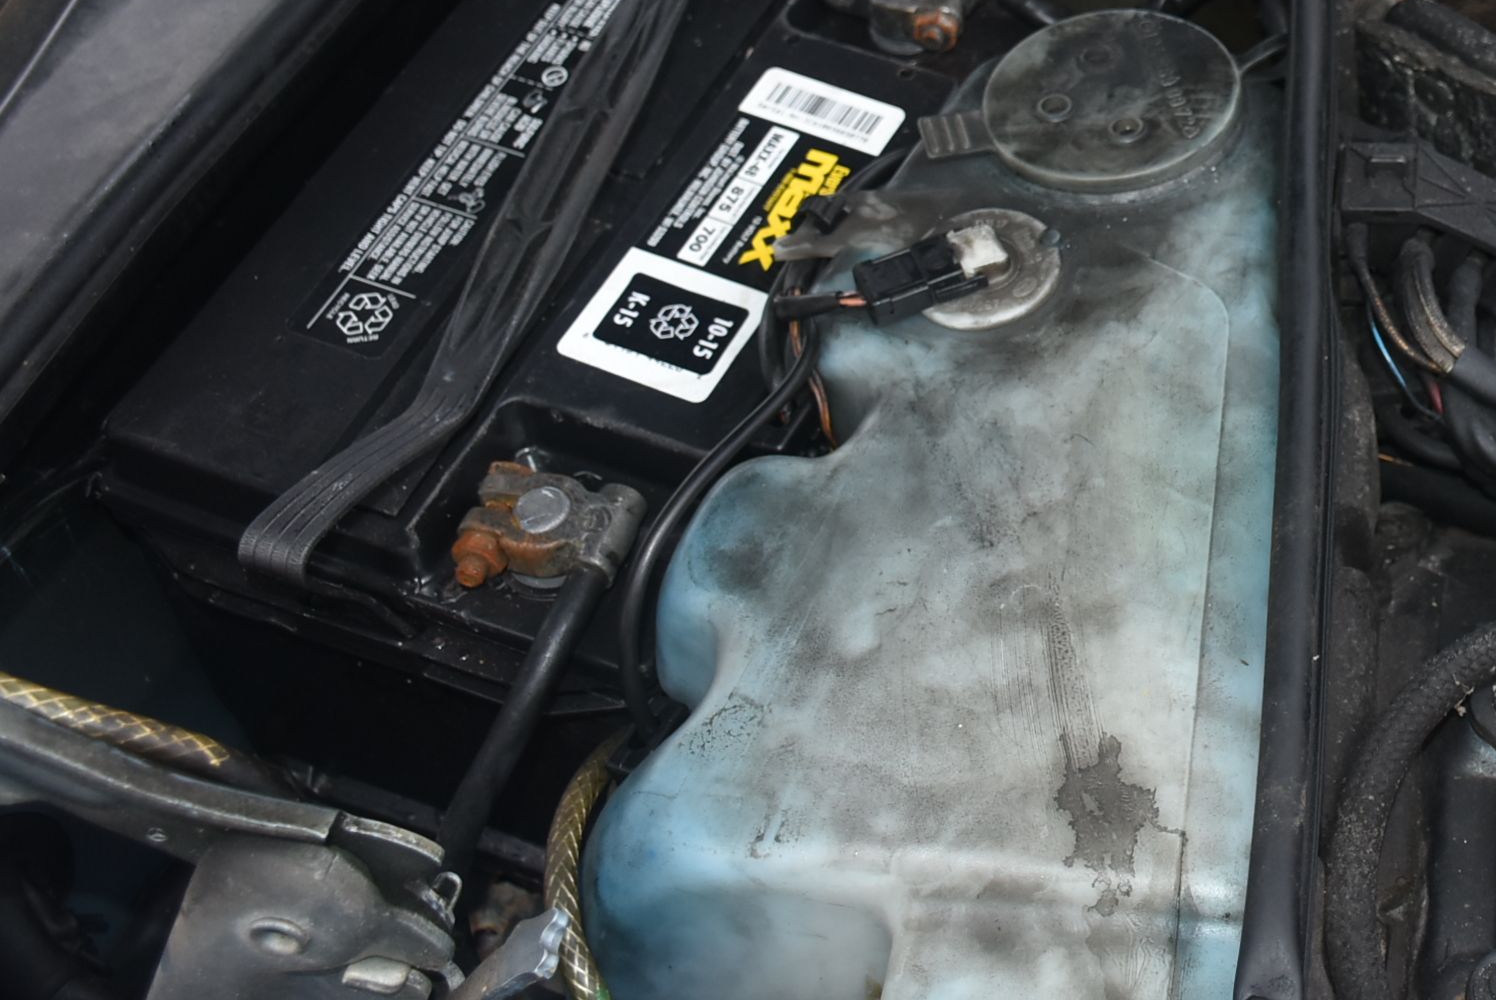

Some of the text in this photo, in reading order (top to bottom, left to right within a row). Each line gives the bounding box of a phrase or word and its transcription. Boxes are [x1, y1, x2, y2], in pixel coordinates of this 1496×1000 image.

[818, 165, 852, 196] EverS
[719, 186, 744, 212] 875
[689, 227, 716, 252] 700
[613, 291, 651, 328] K-15
[692, 317, 734, 359] 10-15
